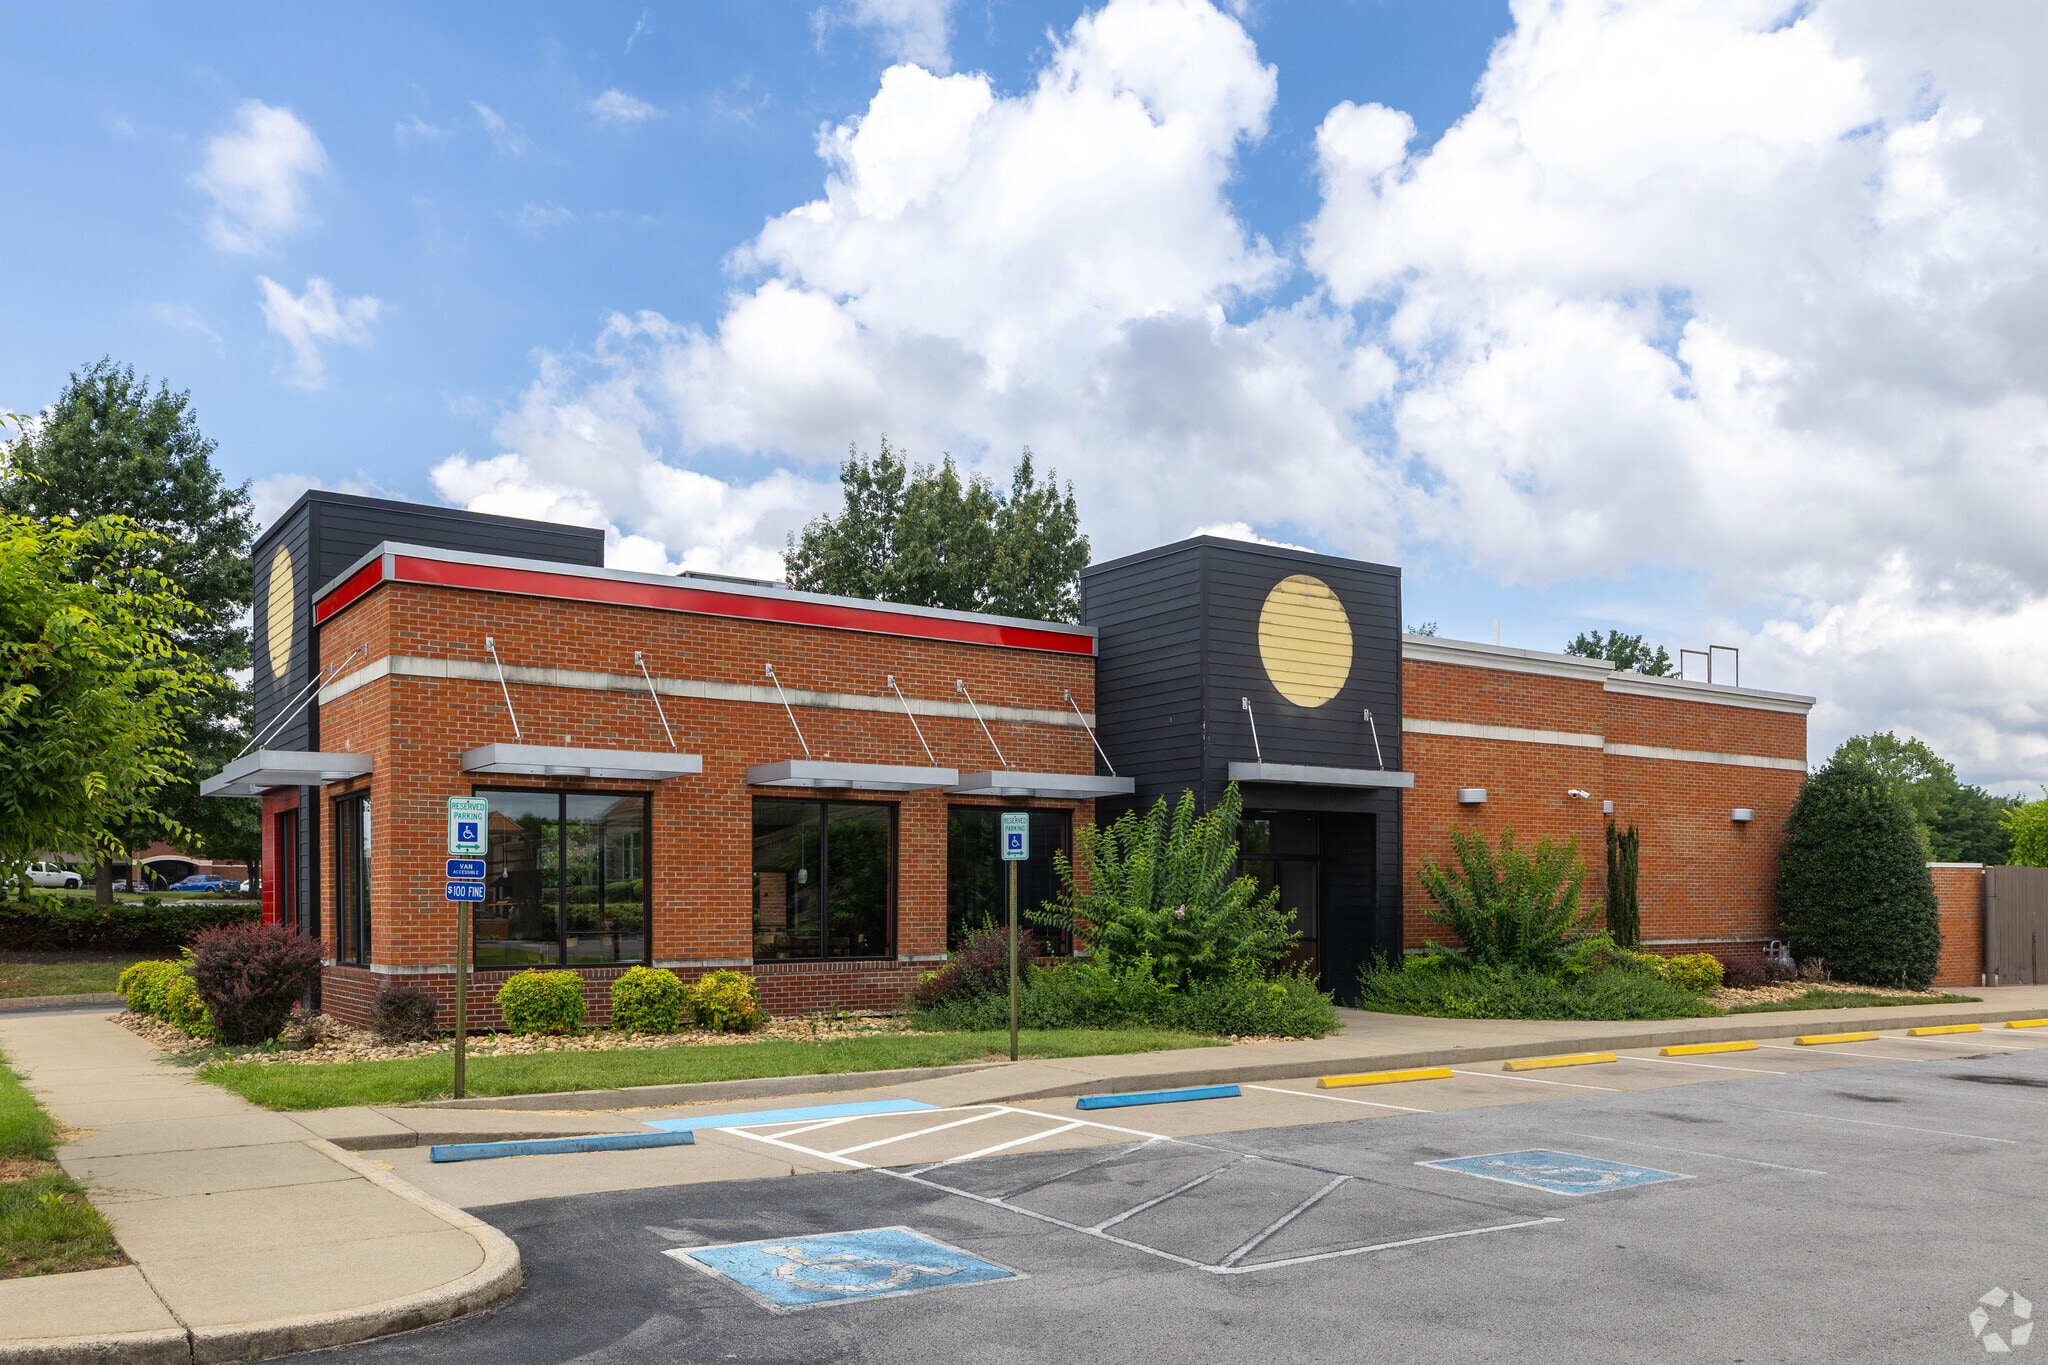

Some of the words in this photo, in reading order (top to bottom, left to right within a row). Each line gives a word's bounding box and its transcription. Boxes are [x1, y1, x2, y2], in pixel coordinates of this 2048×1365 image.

[452, 802, 484, 811] RESERVED
[454, 812, 482, 820] PARKING
[448, 886, 466, 897] $100
[468, 886, 484, 898] FINE
